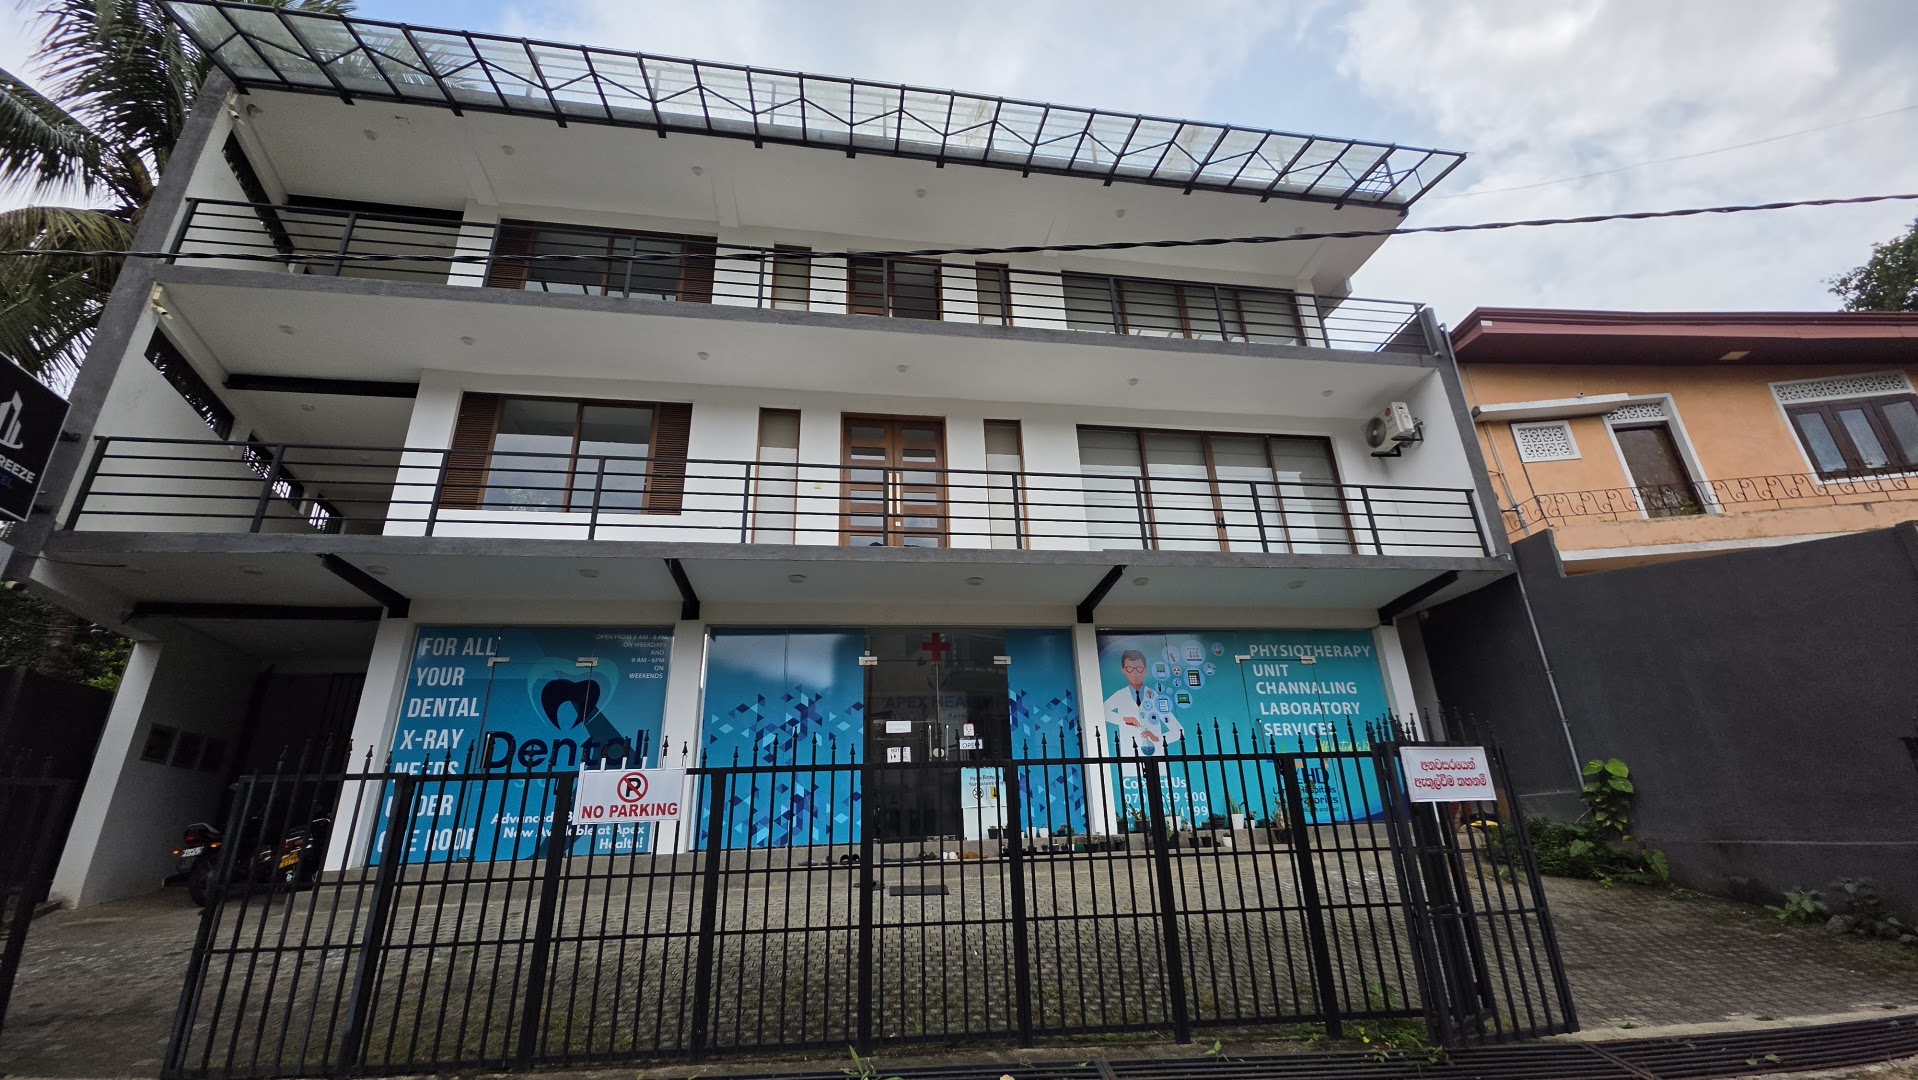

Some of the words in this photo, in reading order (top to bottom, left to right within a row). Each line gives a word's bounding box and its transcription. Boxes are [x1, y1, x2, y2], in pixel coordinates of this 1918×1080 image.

[421, 637, 457, 656] FOR
[462, 637, 496, 656] ALL
[1249, 644, 1371, 658] PHYSIOTHERAPY
[416, 666, 466, 686] YOUR
[1253, 664, 1289, 678] UNIT
[1256, 681, 1358, 695] CHANNALING
[407, 697, 480, 717] DENTAL
[1260, 701, 1360, 715] LABORATORY
[1264, 722, 1336, 737] SERVICES
[400, 728, 464, 750] X-RAY
[484, 730, 645, 769] Dental
[1420, 757, 1476, 772] අනවසරයෙන්
[1171, 776, 1187, 788] Us
[1458, 773, 1487, 787] තහනම්
[385, 795, 454, 817] DER
[581, 804, 604, 819] NO
[608, 802, 678, 818] PARKING
[597, 825, 611, 835] at
